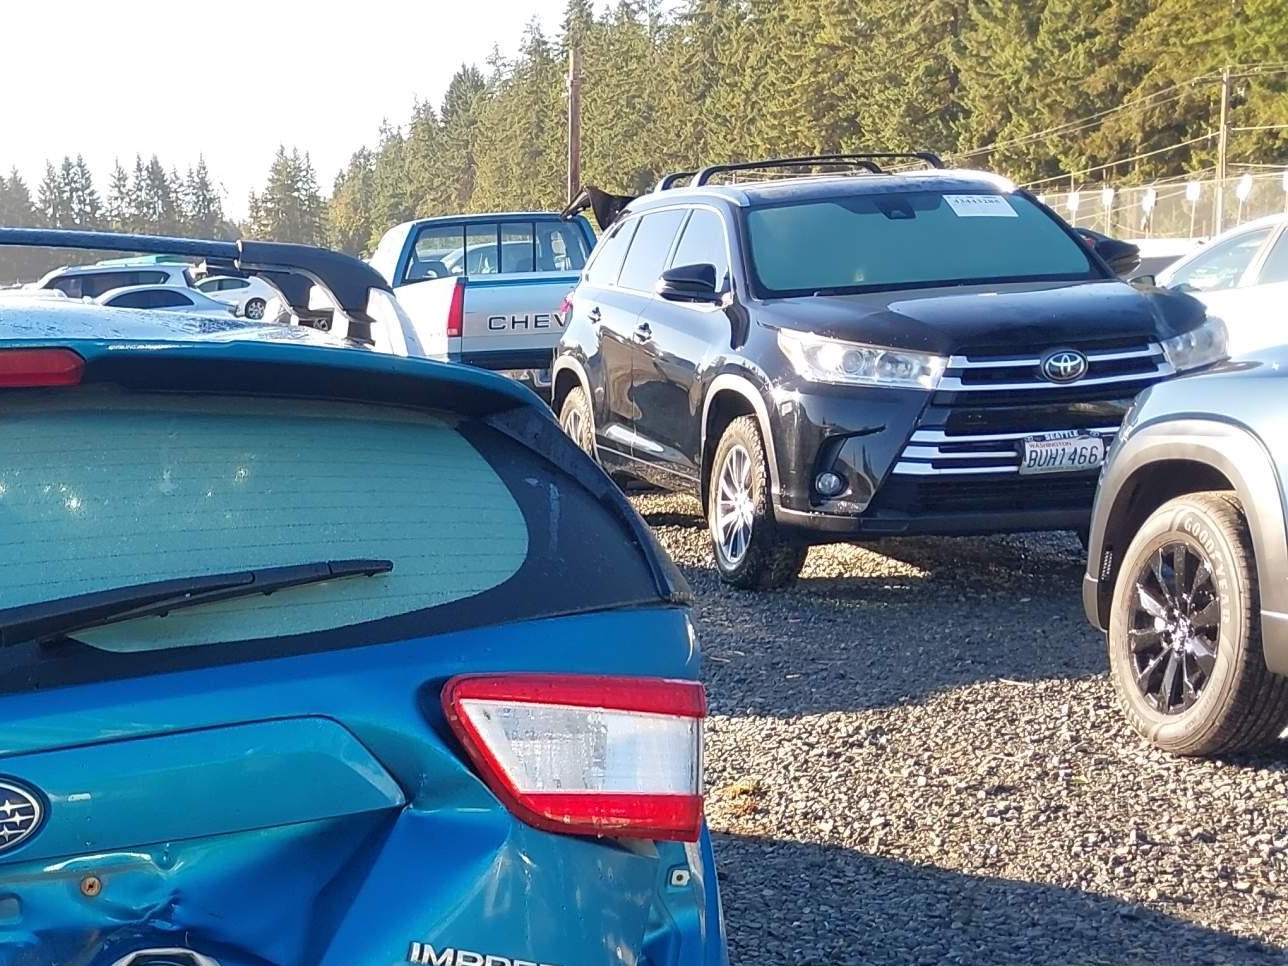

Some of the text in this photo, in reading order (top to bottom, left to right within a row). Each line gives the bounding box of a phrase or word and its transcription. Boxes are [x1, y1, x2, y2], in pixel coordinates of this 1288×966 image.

[1029, 441, 1072, 449] WASHINGTON
[1027, 446, 1099, 468] BUH1466
[1184, 517, 1231, 624] GOODYEAR
